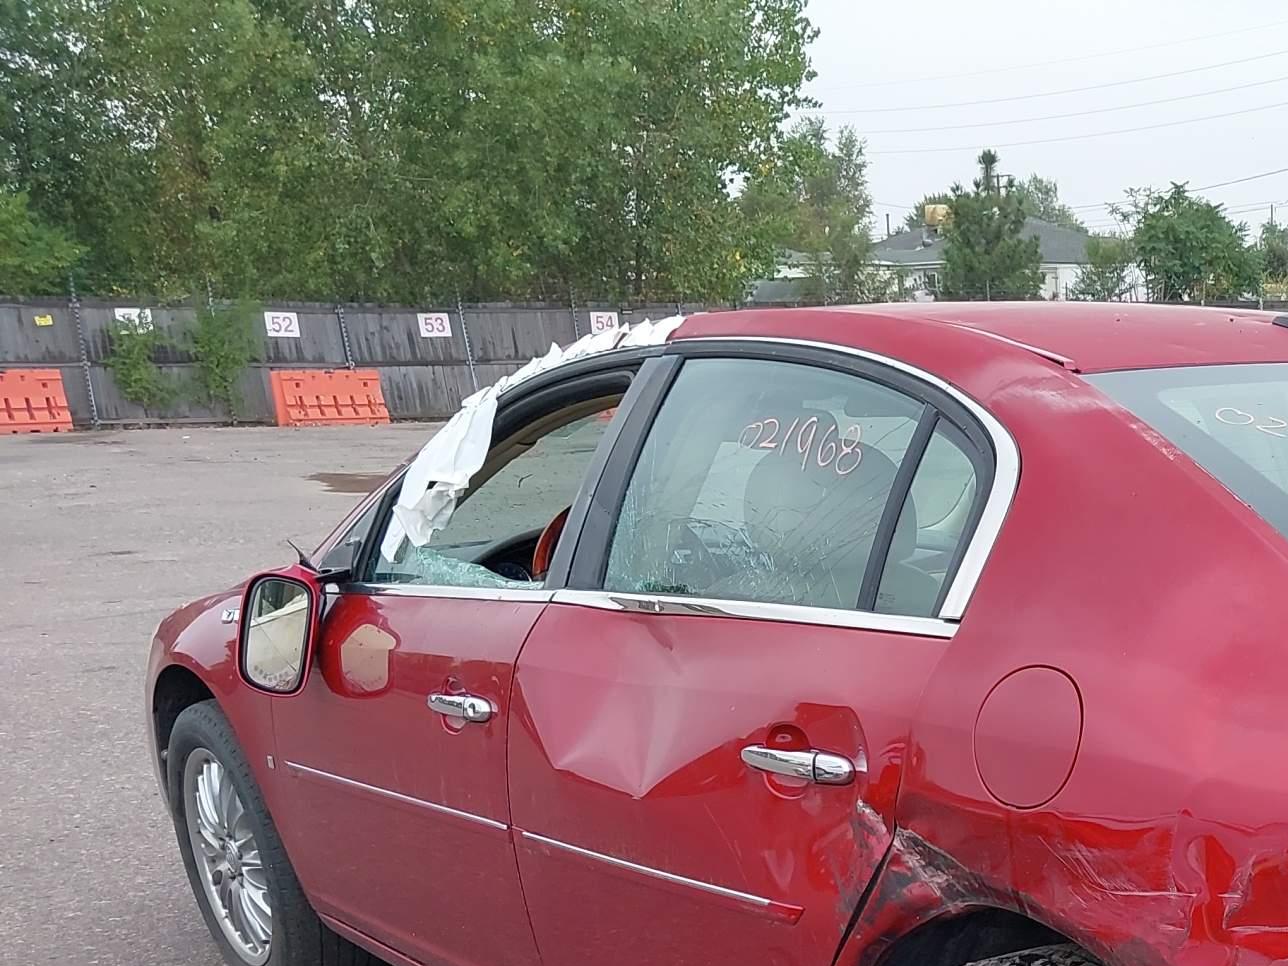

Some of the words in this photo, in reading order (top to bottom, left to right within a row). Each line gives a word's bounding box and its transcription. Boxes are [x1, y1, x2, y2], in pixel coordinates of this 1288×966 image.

[271, 316, 295, 333] 52
[424, 316, 447, 333] 53
[595, 315, 615, 331] 54
[737, 416, 863, 476] 021968
